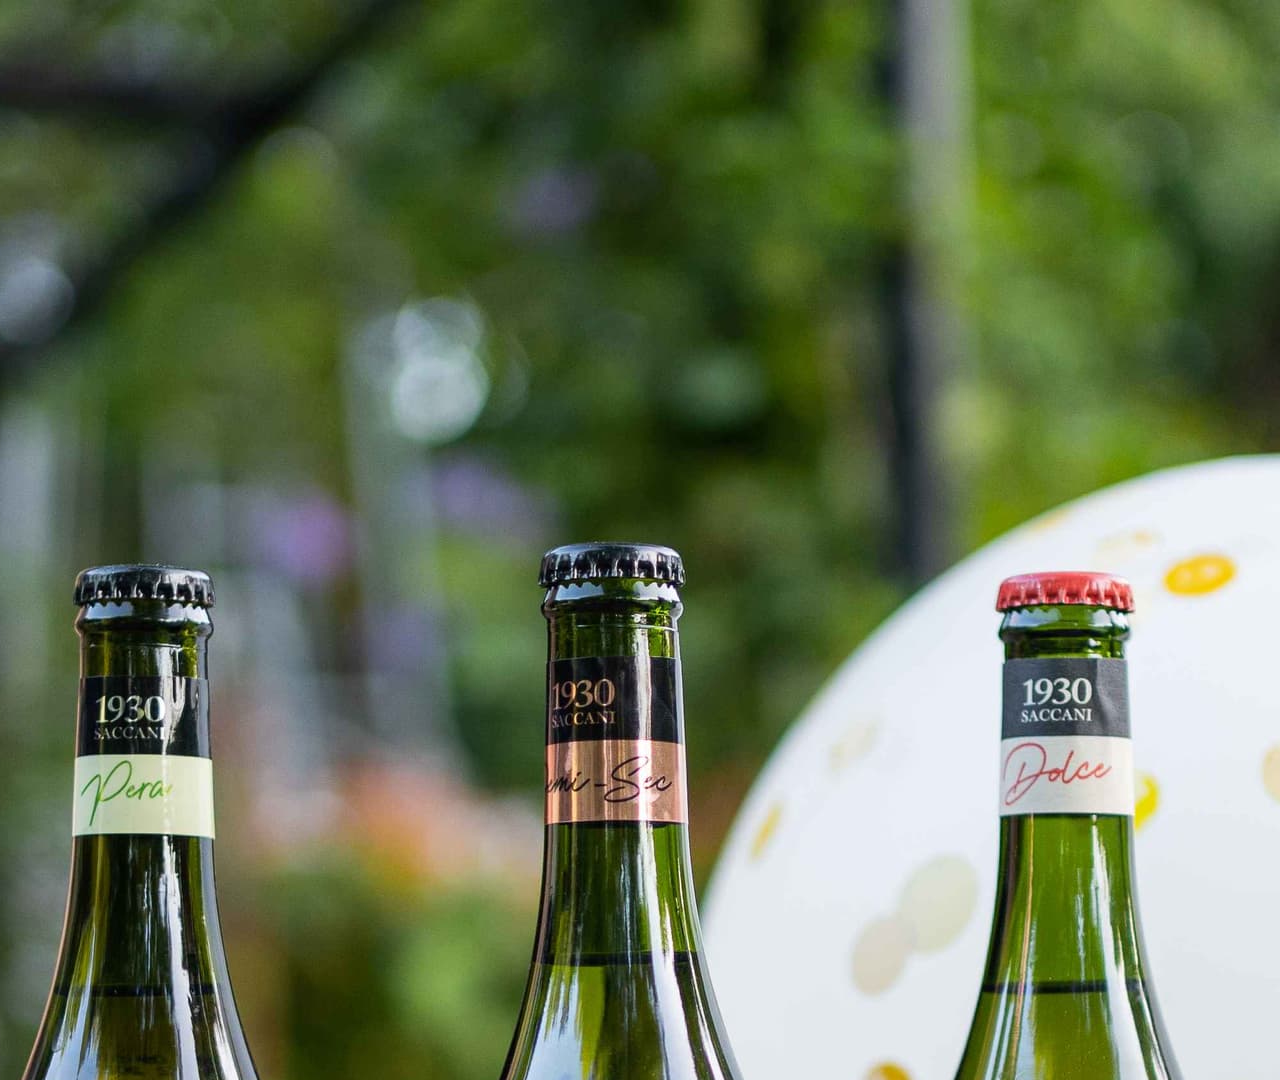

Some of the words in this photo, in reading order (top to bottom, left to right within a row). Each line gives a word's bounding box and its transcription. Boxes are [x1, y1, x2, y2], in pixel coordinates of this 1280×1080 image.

[552, 678, 616, 710] 1930
[1022, 677, 1093, 706] 1930
[94, 694, 166, 724] 1930
[551, 711, 616, 728] SACCANI
[1020, 707, 1093, 723] SACCANI
[93, 725, 167, 741] SACCANI
[544, 755, 673, 804] emi-Sec
[1003, 742, 1113, 806] Dolce
[81, 759, 171, 827] Pera
